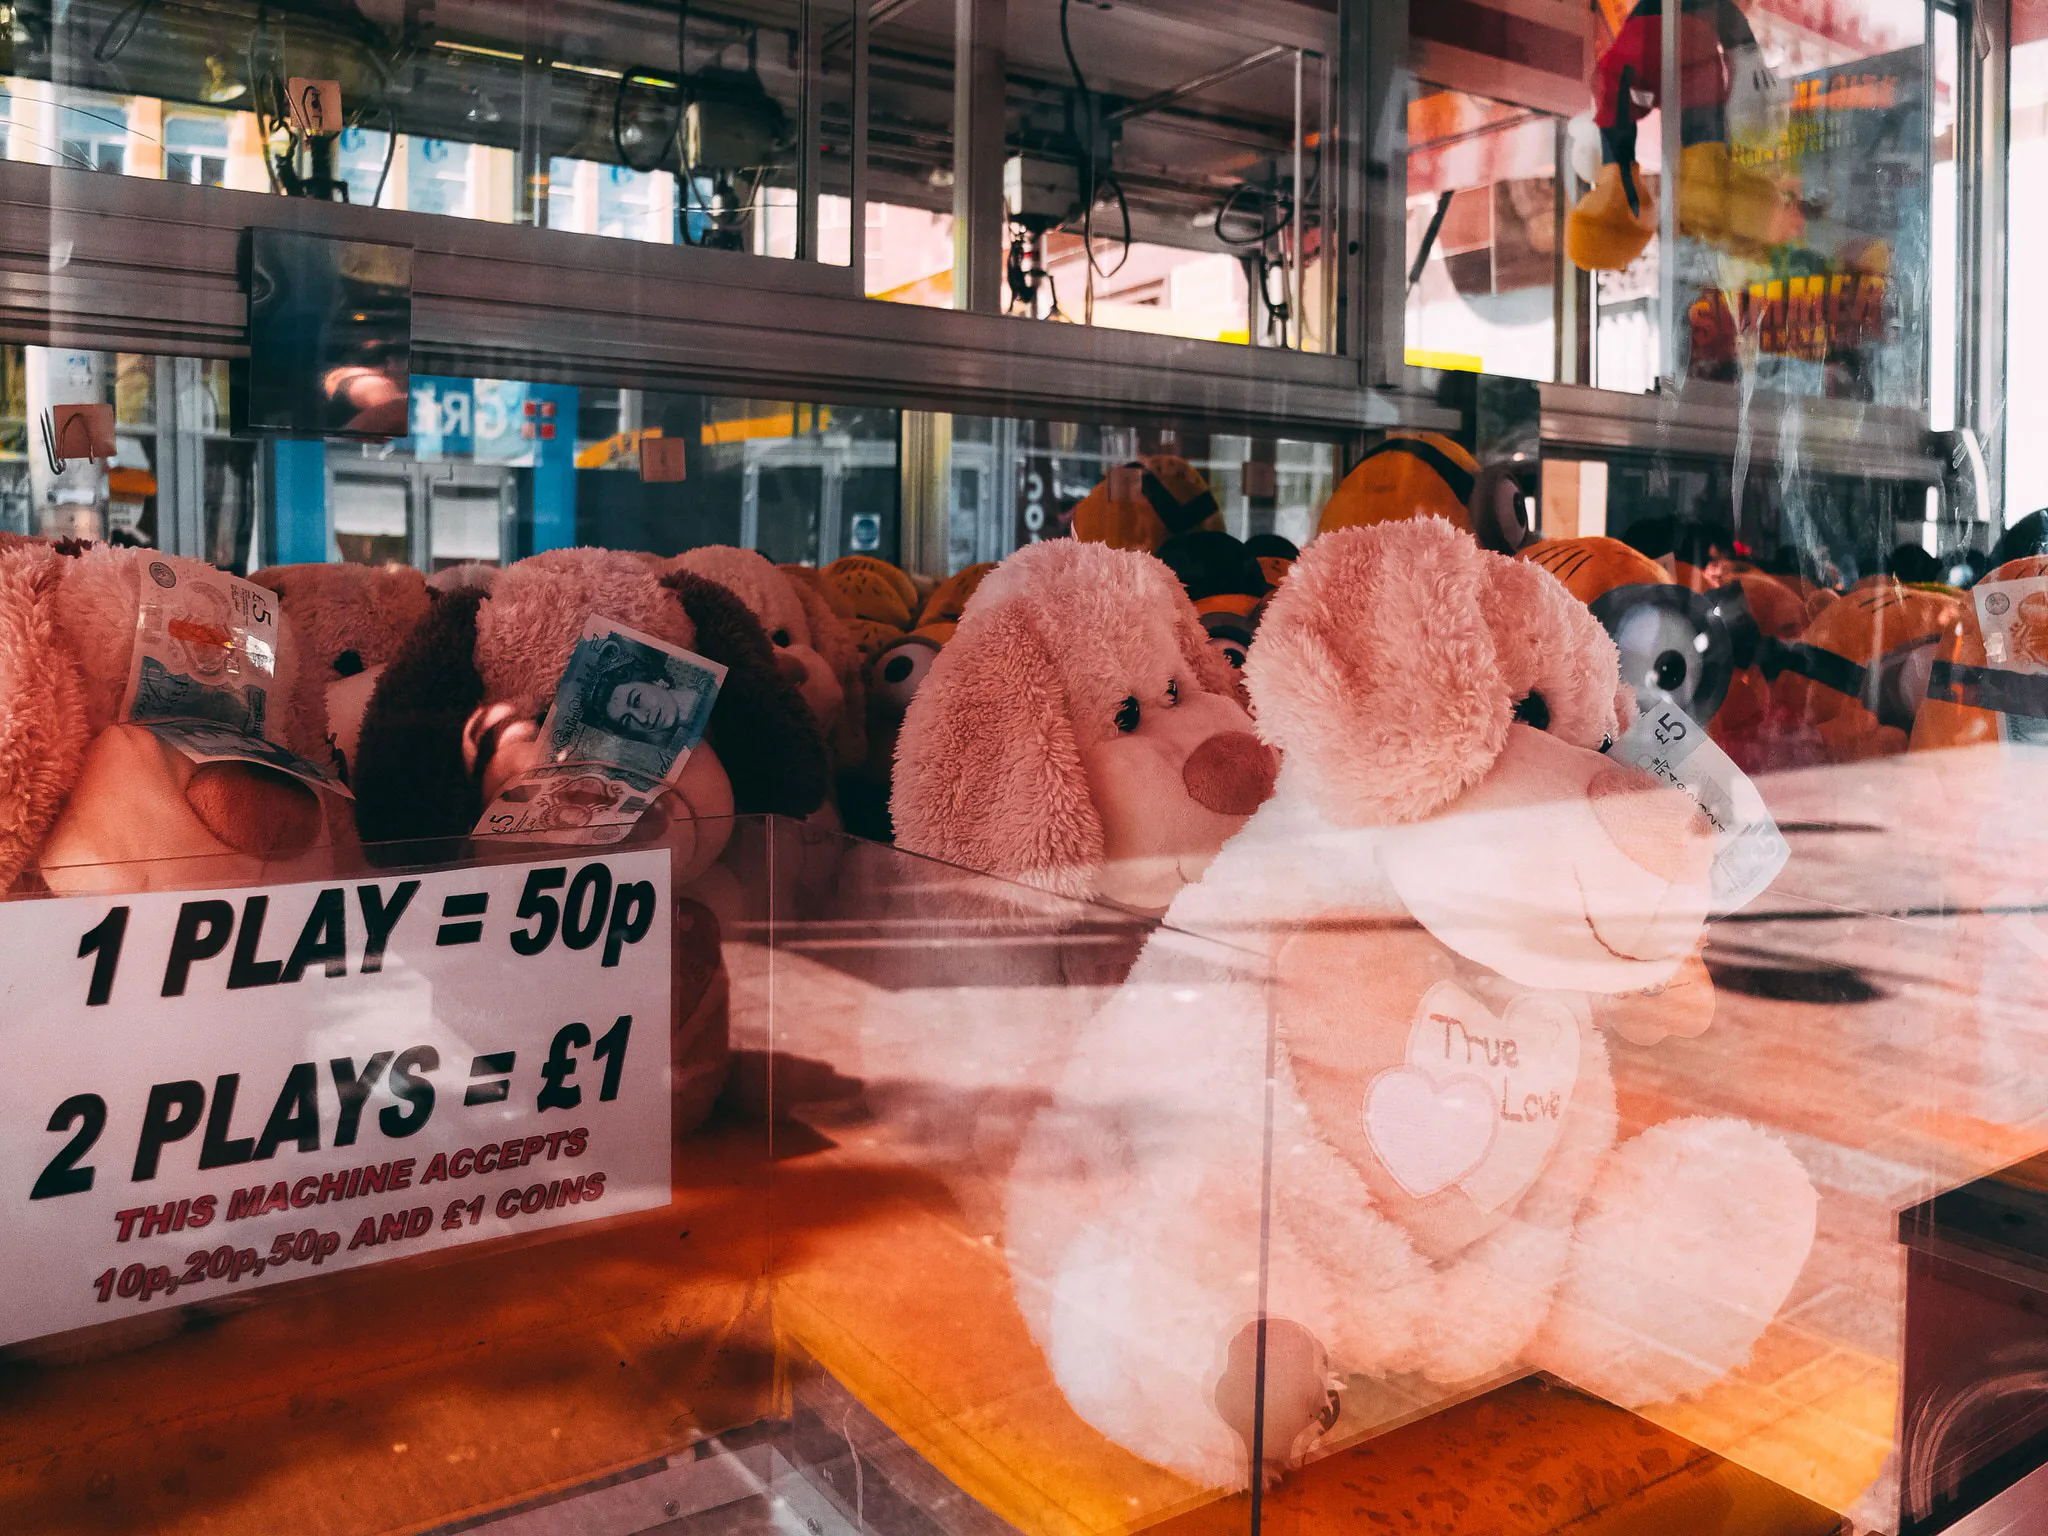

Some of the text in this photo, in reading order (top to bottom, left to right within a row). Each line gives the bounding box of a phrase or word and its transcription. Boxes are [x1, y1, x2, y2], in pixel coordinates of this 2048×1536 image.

[1654, 712, 1687, 745] £5
[76, 862, 656, 1006] 1 PLAY = 50p
[1430, 1013, 1520, 1069] True
[29, 1015, 633, 1200] 2 PLAYS = £1
[1500, 1077, 1561, 1122] Love
[93, 1172, 607, 1303] 10p,20p,50p AND £1 COINS
[114, 1127, 589, 1243] THIS MACHINE ACCEPTS
